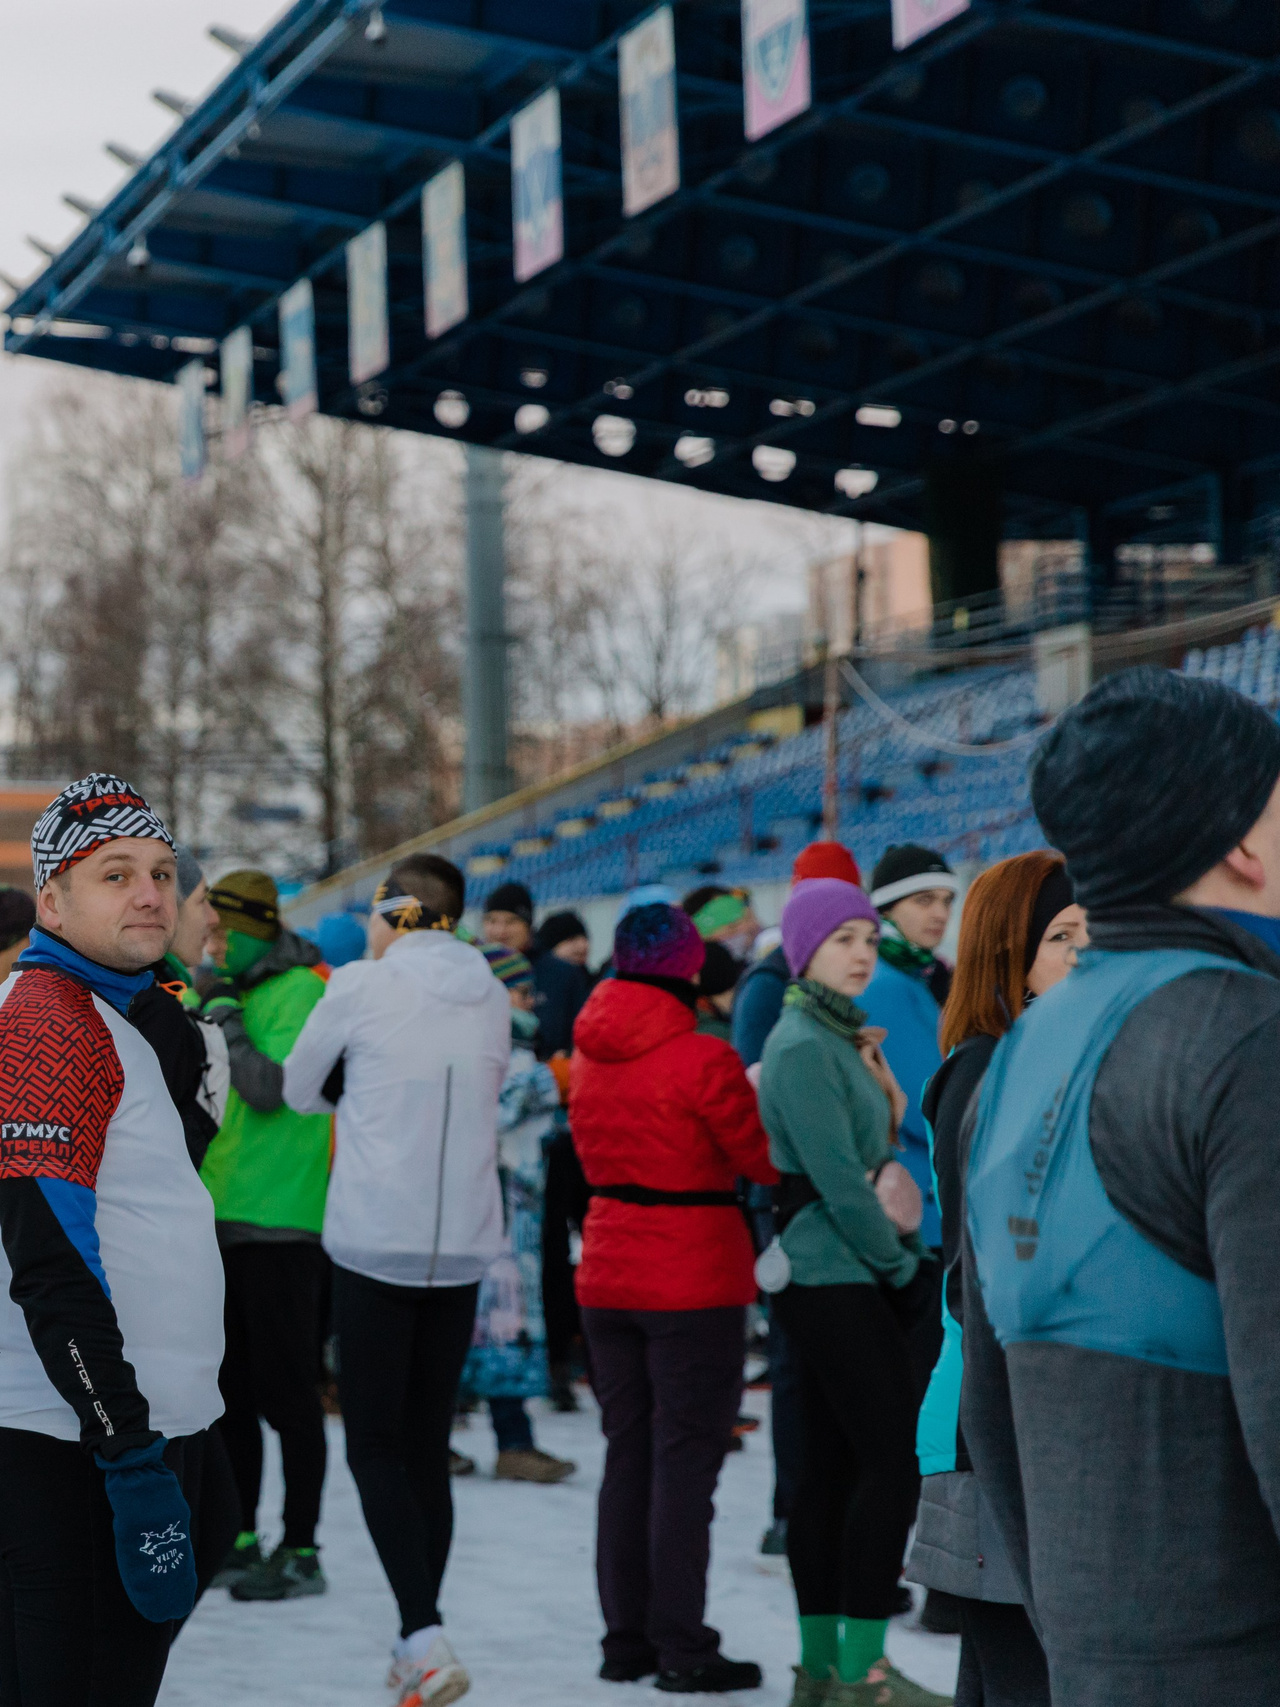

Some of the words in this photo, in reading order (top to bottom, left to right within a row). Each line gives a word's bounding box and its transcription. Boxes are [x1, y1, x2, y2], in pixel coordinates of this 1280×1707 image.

[1, 1122, 71, 1142] ГУМУС
[3, 1139, 70, 1158] ТРЕЙЛ
[68, 1338, 97, 1396] VICTORY
[94, 1400, 115, 1437] CODE
